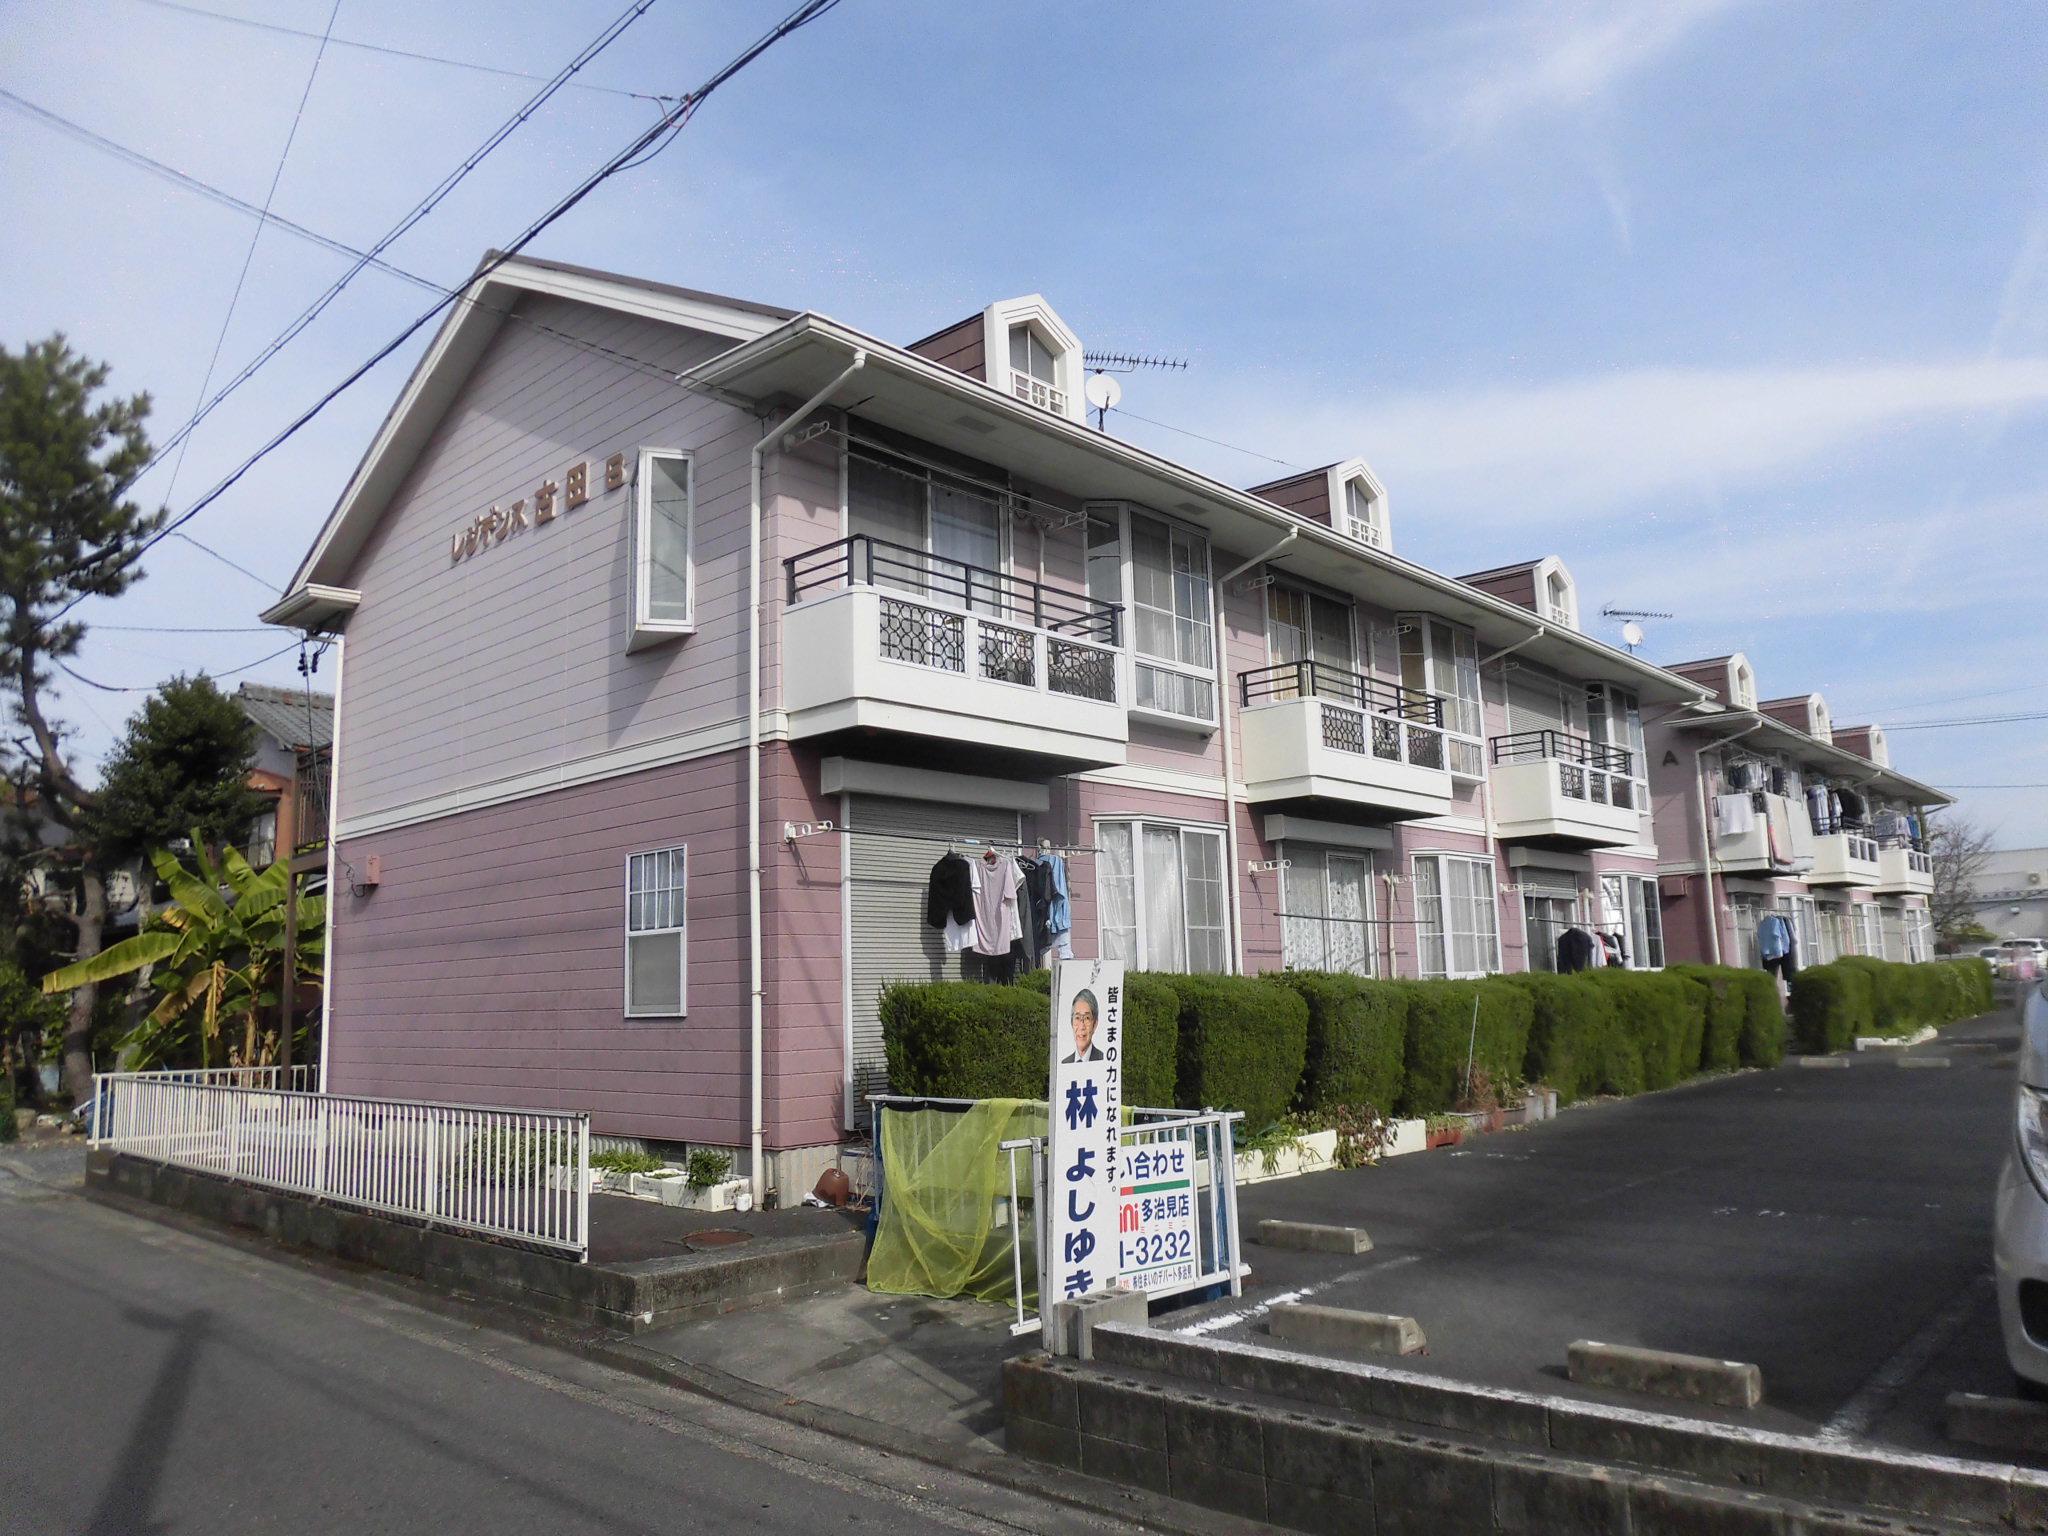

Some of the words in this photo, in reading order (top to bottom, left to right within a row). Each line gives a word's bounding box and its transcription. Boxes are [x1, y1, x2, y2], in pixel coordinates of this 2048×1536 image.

[1662, 750, 1679, 767] A
[1105, 985, 1119, 1193] 皆さまの力になれます。
[1141, 1194, 1190, 1223] 多治見店
